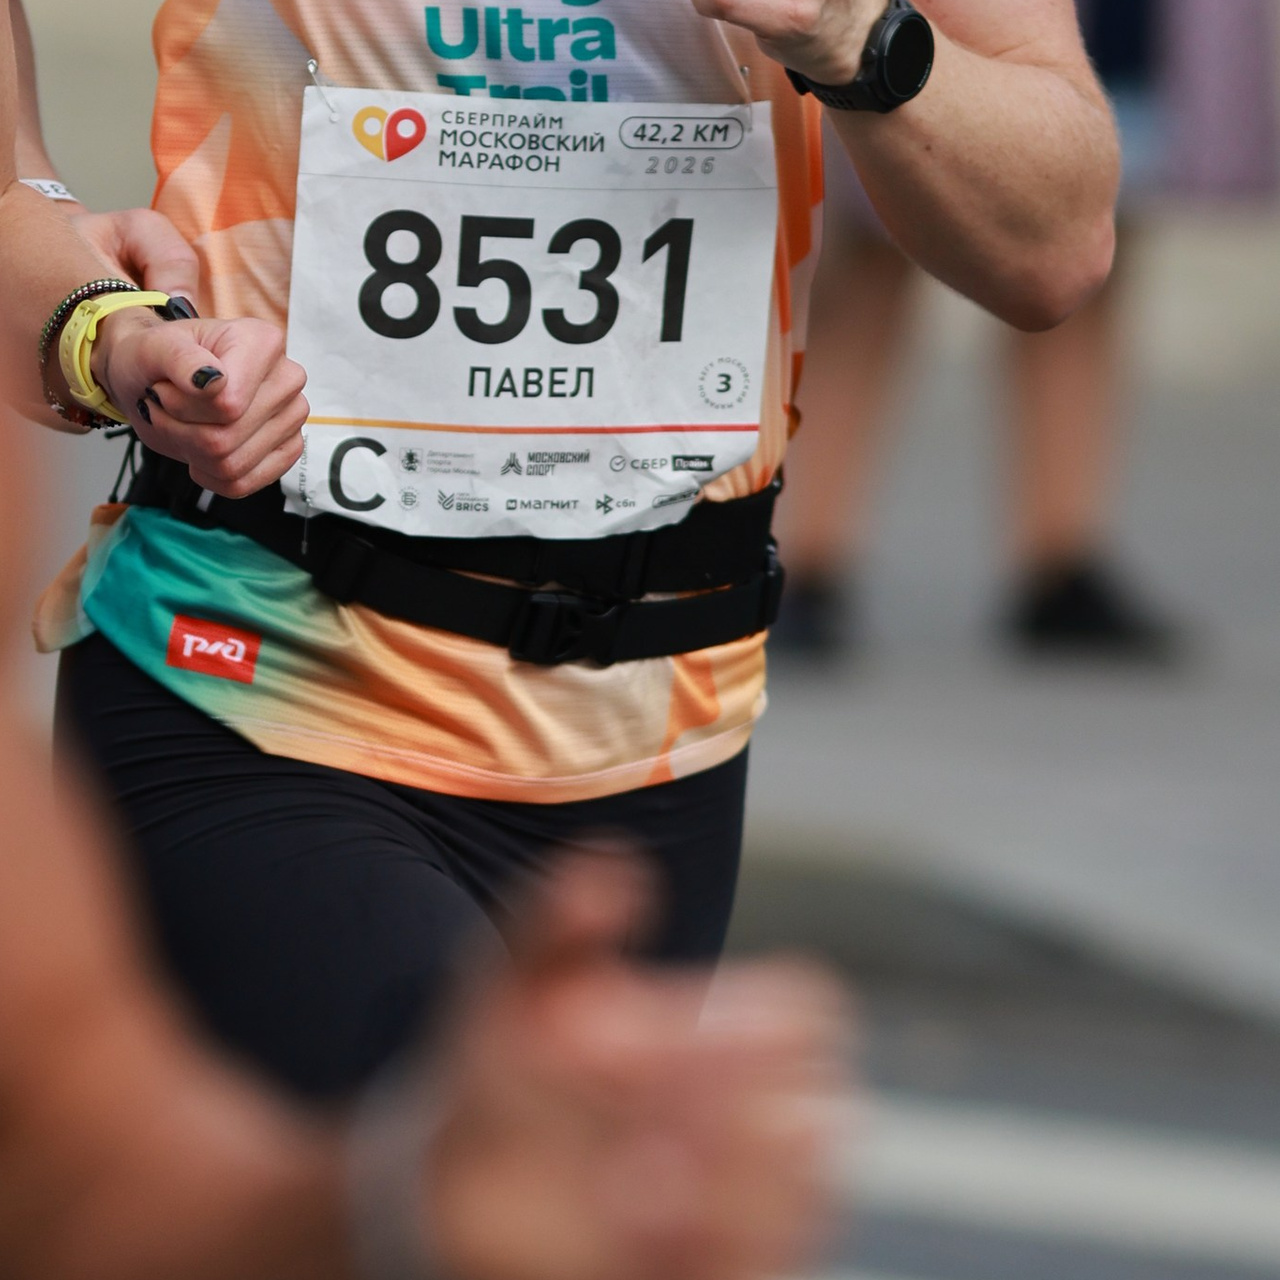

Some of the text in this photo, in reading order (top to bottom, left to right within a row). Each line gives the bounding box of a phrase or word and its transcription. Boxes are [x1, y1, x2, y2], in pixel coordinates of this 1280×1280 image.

[425, 6, 616, 61] Ultra
[441, 110, 564, 130] СБЕРПРАЙМ
[439, 129, 605, 153] МОСКОВСКИЙ
[633, 123, 682, 145] 42,2
[438, 150, 561, 173] МАРАФОН
[645, 155, 715, 175] 2026
[358, 208, 695, 345] 8531
[467, 366, 595, 399] ПАВЕЛ
[716, 372, 732, 393] 3
[527, 448, 591, 464] МОСКОВСКИЙ
[630, 459, 668, 470] СБЕР
[526, 463, 556, 476] СПОРТ
[455, 502, 489, 512] BRICS
